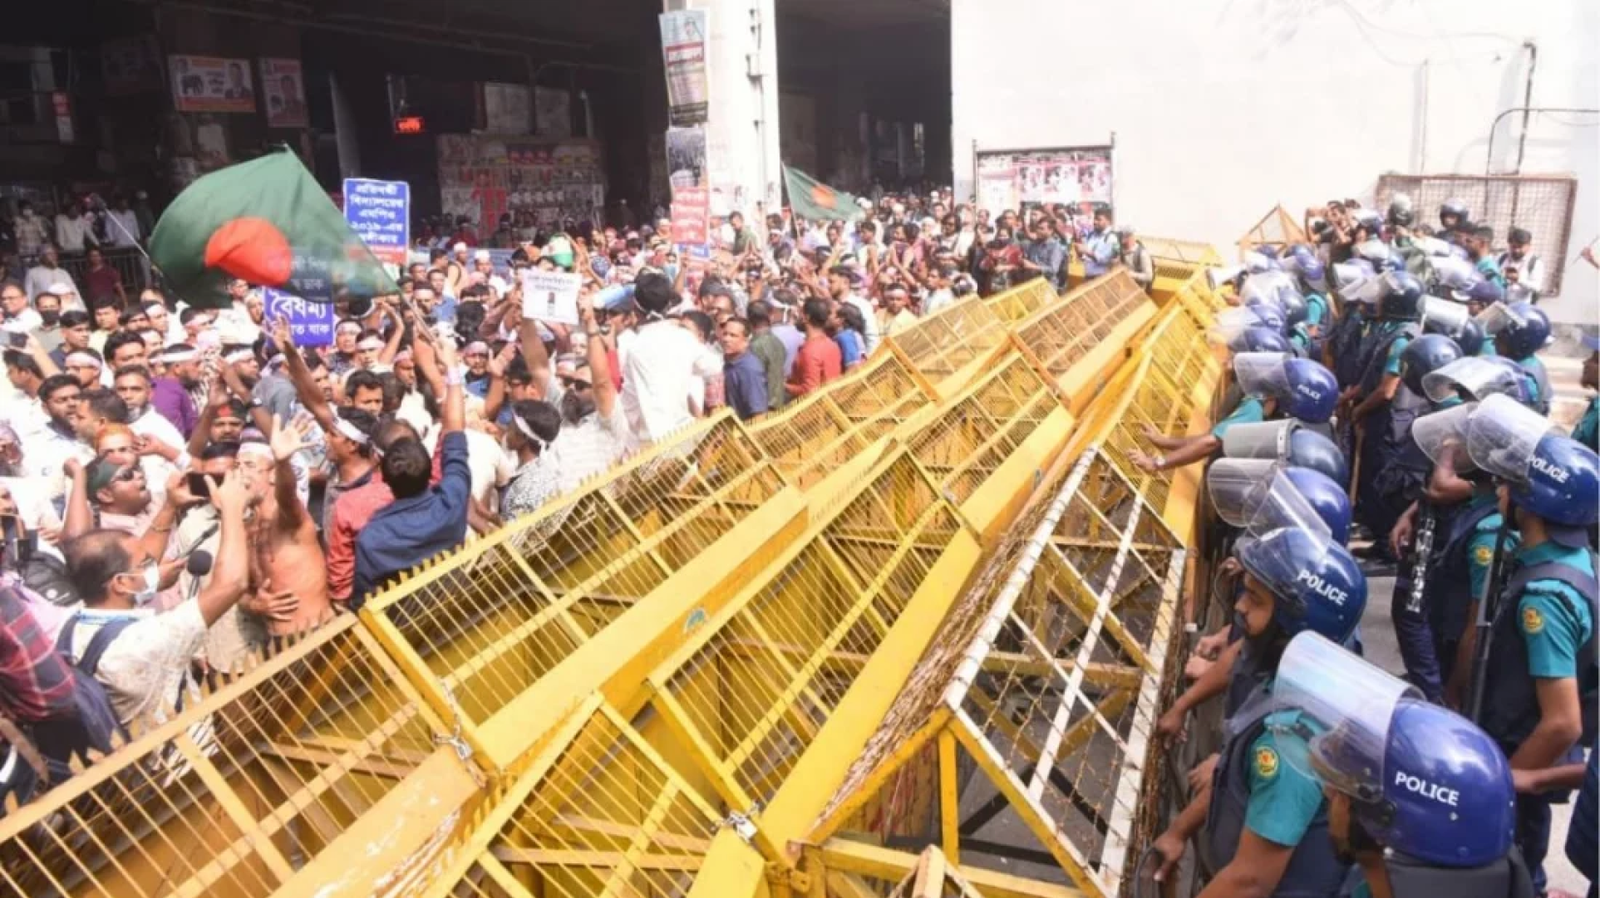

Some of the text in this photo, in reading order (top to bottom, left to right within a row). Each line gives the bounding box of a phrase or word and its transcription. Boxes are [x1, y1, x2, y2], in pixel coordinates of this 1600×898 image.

[1524, 455, 1570, 484] POLICE
[1297, 569, 1349, 606] POLICE
[1395, 771, 1460, 807] POLICE
